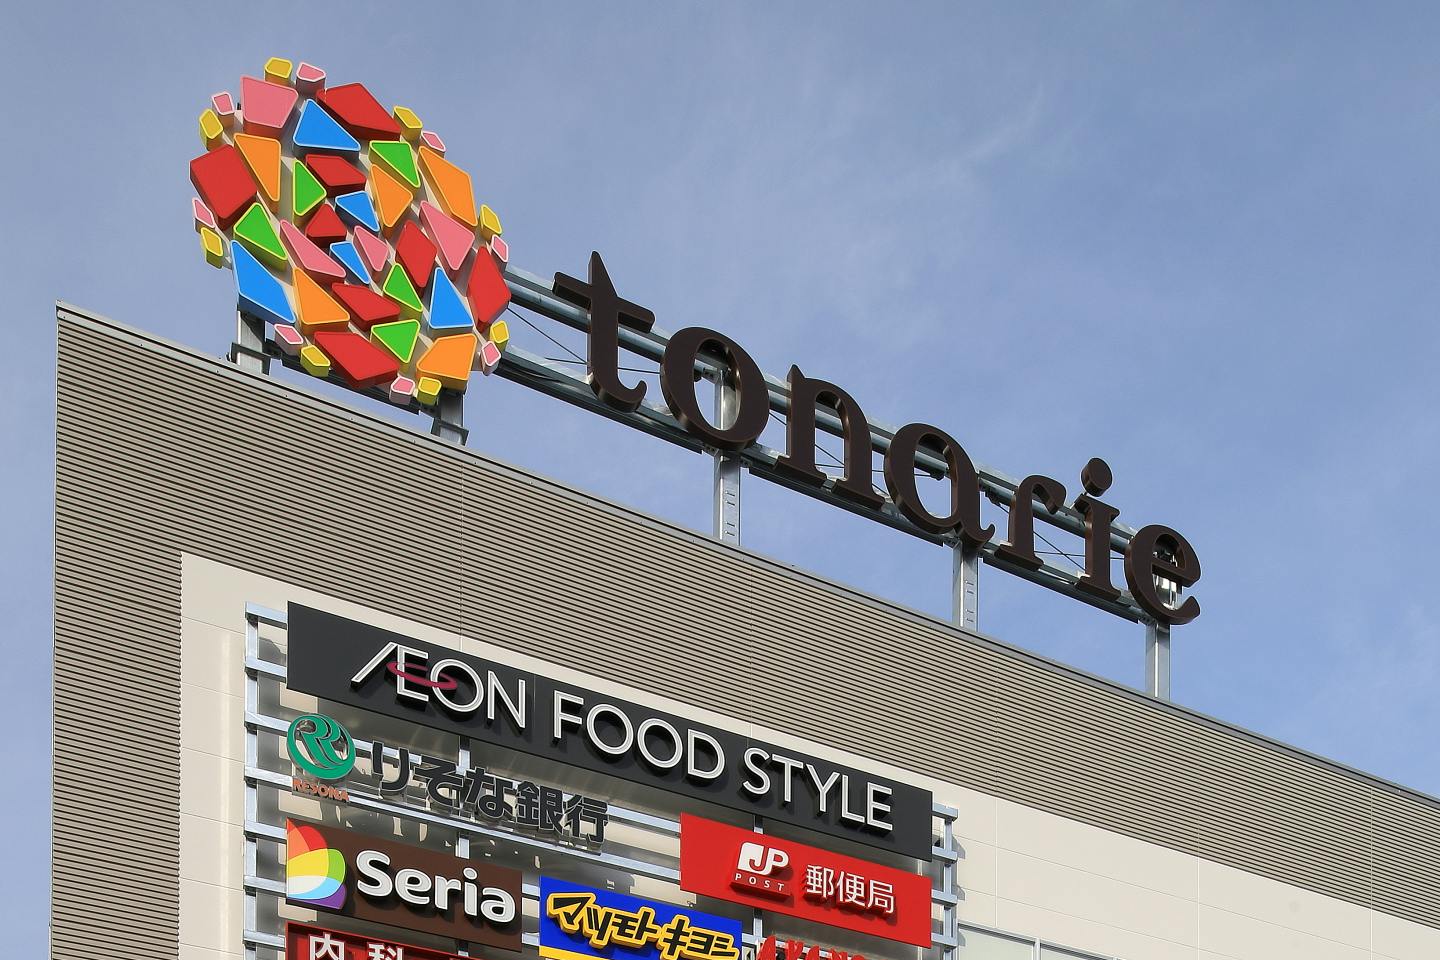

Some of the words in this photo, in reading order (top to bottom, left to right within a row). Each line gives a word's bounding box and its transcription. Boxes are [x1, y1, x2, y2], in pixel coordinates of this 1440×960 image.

[552, 250, 1202, 625] tonarie
[292, 779, 350, 801] RESONA
[370, 740, 610, 844] りそな銀行
[552, 689, 726, 782] FOOD
[742, 746, 895, 832] STYLE
[355, 849, 517, 925] Seria
[735, 873, 786, 892] POST
[806, 864, 895, 914] 郵便局
